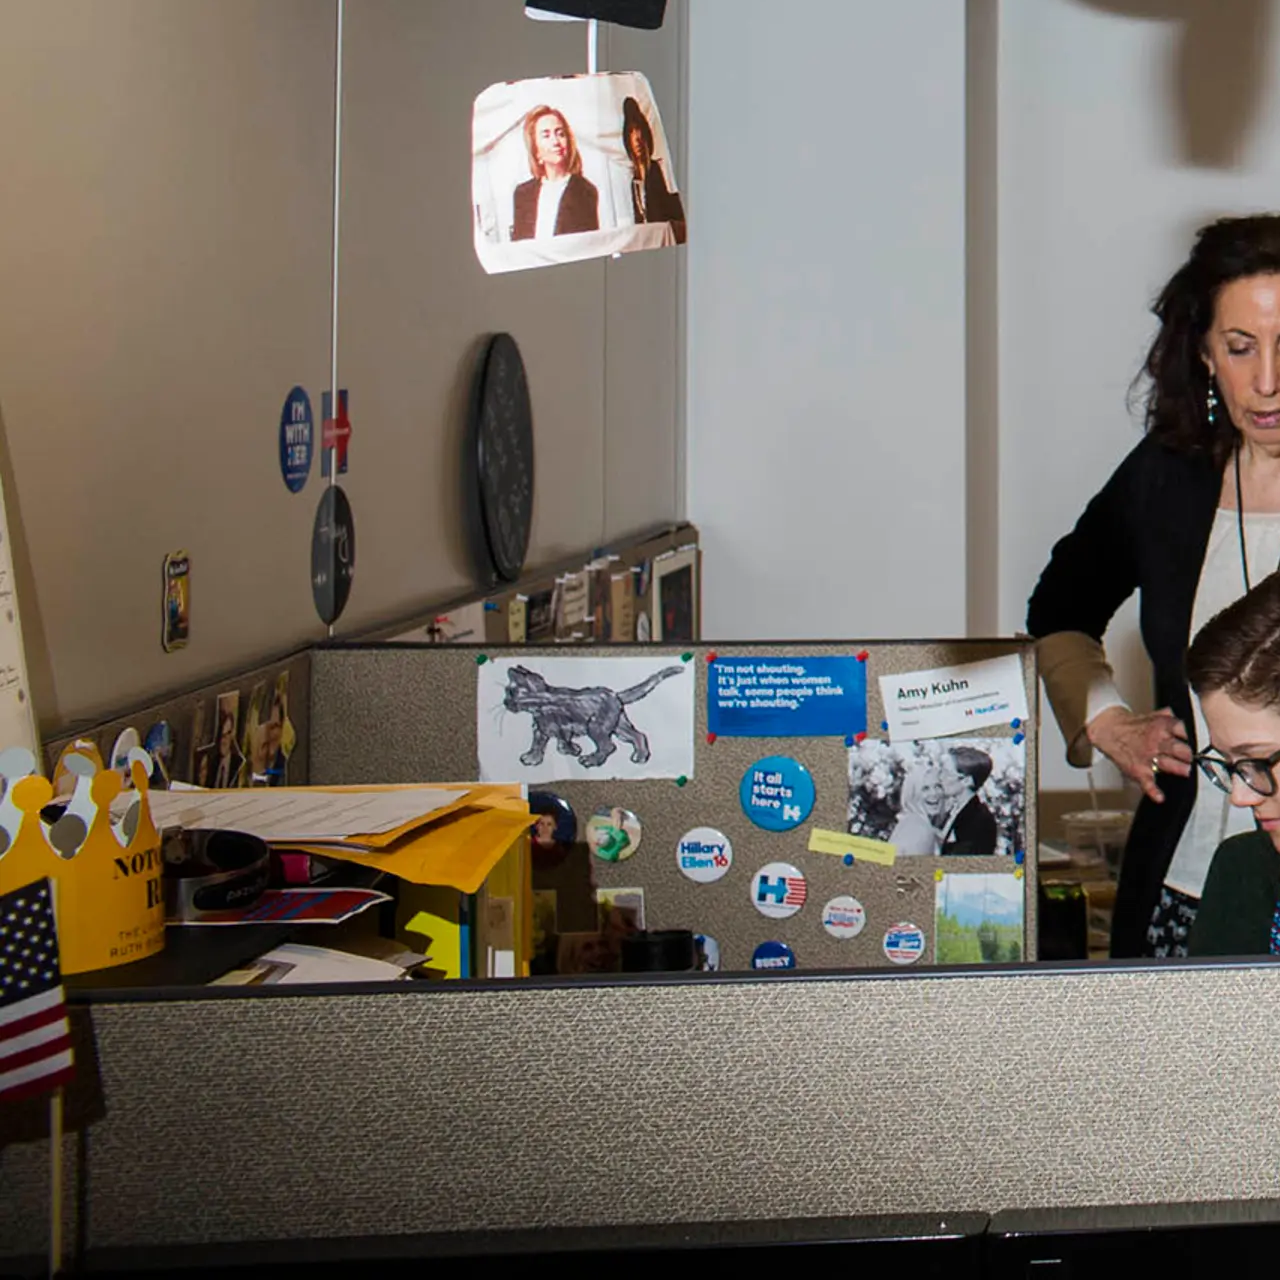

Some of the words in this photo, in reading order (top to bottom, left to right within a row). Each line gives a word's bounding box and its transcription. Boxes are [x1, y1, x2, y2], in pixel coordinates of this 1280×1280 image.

[285, 422, 310, 445] WITH
[736, 664, 755, 674] not
[736, 675, 757, 687] just
[759, 675, 789, 685] when
[791, 676, 832, 685] women
[744, 688, 774, 697] some
[776, 687, 813, 699] people
[816, 686, 844, 696] think
[897, 687, 929, 700] Amy
[931, 678, 969, 696] Kuhn
[718, 698, 748, 708] we're
[753, 771, 763, 782] It
[766, 772, 782, 785] all
[752, 783, 793, 798] starts
[752, 795, 782, 809] here
[680, 841, 725, 857] Hillary
[682, 856, 713, 869] Ellen
[110, 943, 143, 958] RUTH
